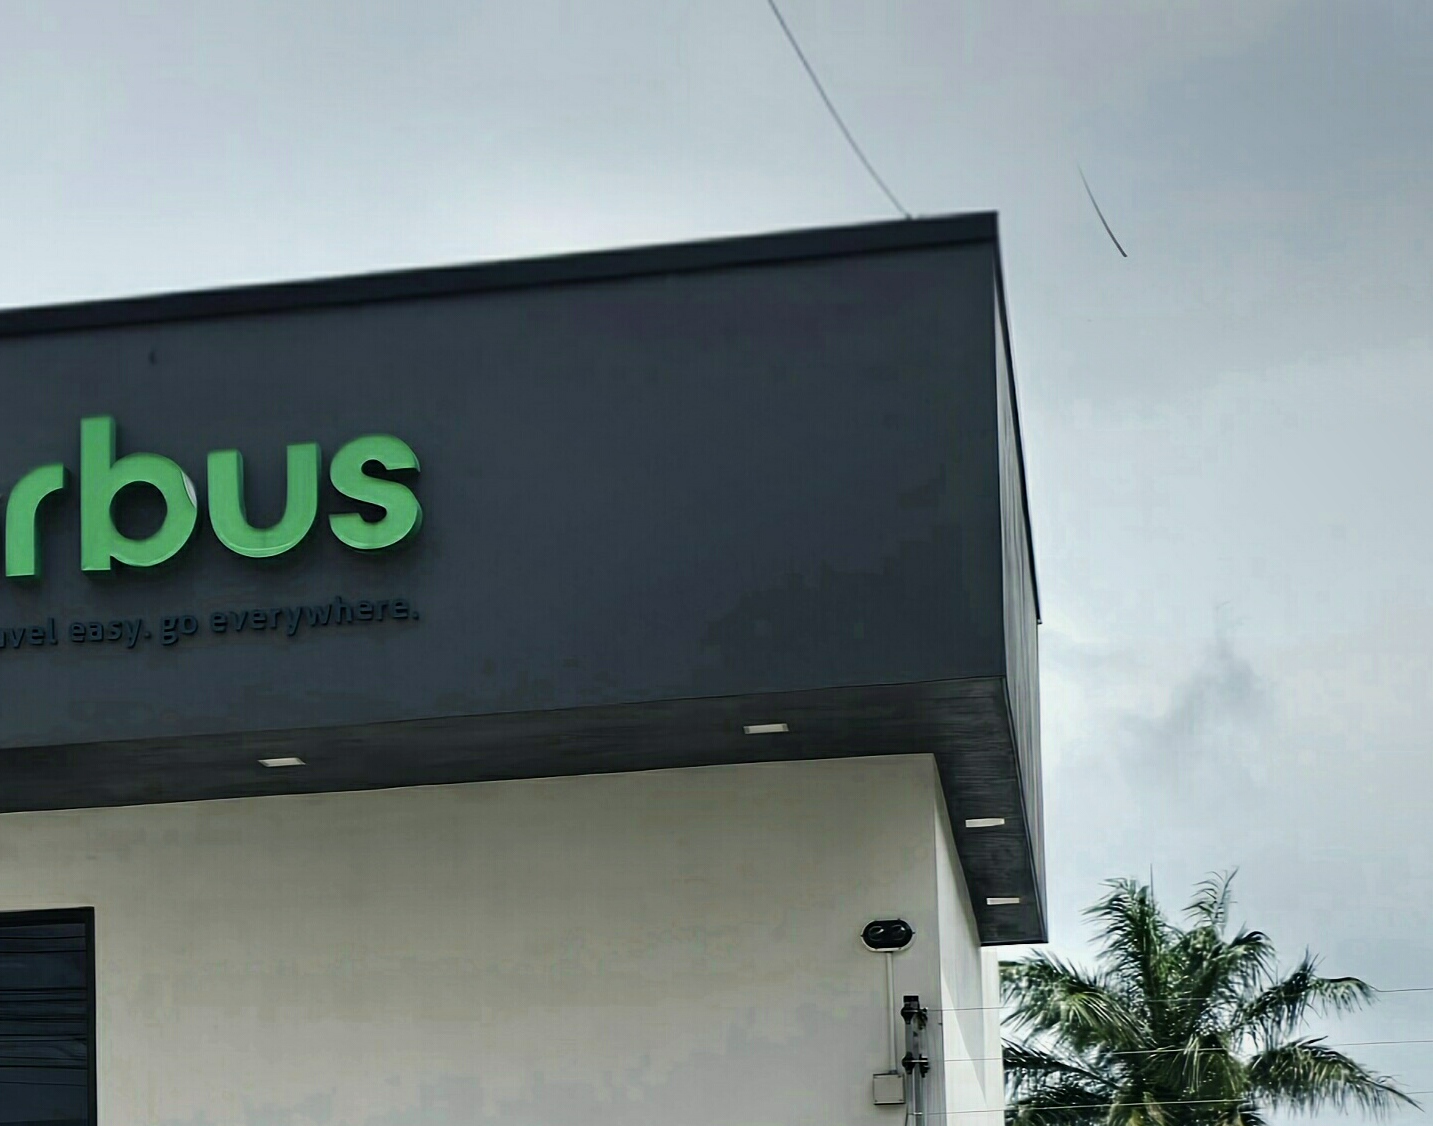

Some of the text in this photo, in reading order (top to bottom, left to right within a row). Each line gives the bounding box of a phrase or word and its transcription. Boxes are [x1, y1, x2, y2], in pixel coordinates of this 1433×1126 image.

[69, 616, 152, 649] easy.
[161, 611, 198, 645] go
[209, 595, 421, 637] everywhere.
